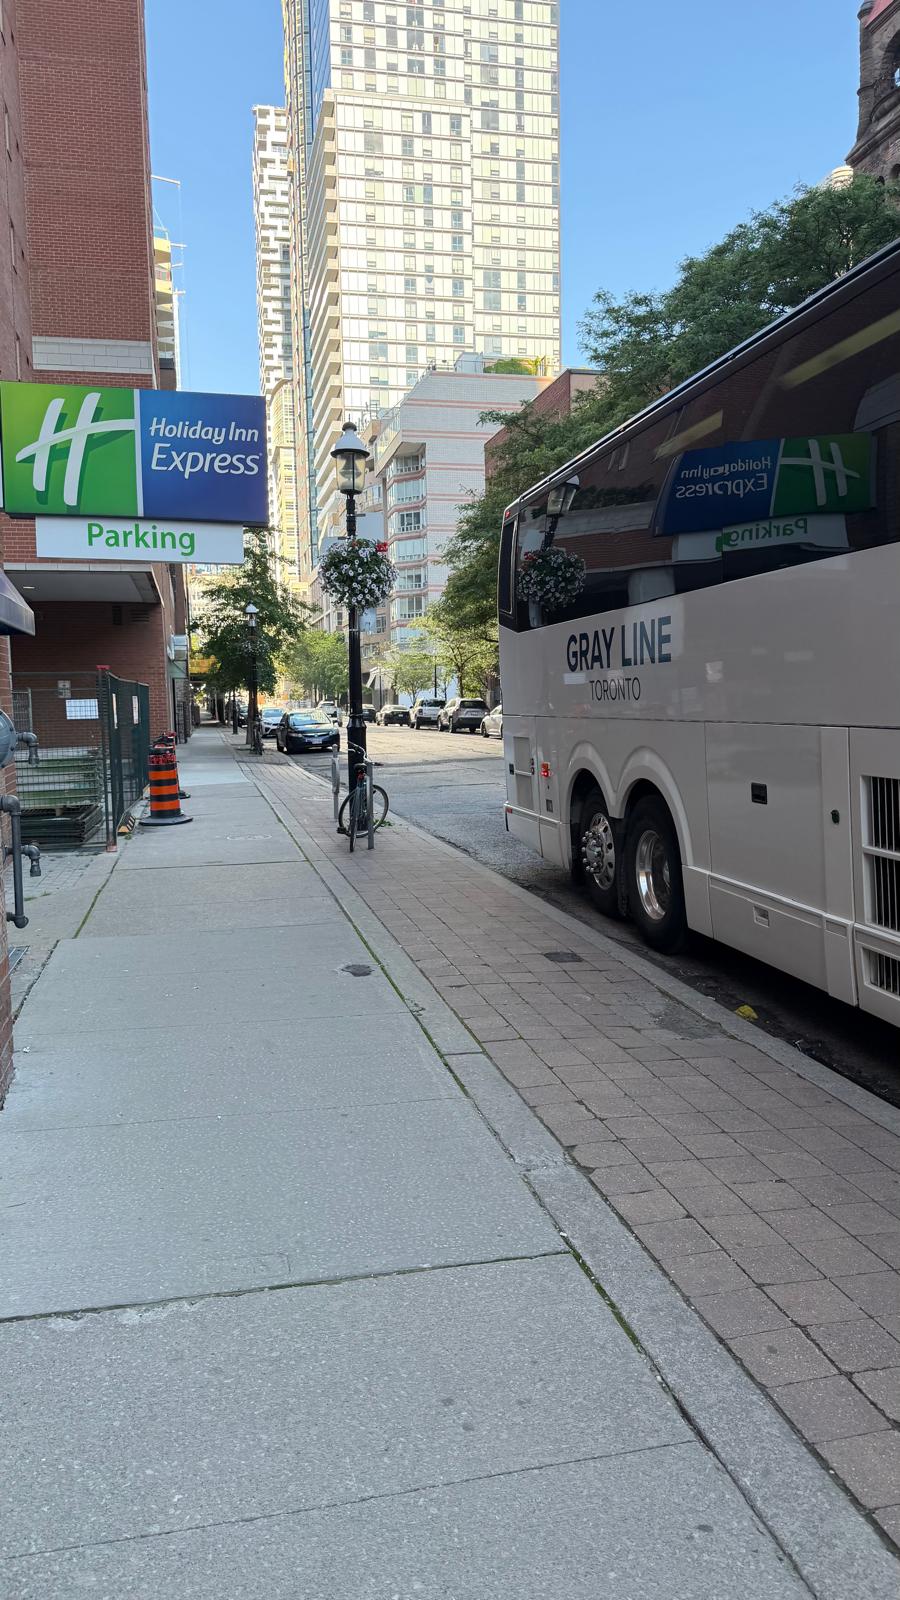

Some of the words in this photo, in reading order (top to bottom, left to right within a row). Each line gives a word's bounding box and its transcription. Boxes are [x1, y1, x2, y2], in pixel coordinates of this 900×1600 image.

[149, 417, 227, 443] Holiday
[229, 422, 259, 443] Inn
[151, 443, 260, 479] Express
[87, 522, 195, 556] Parking
[567, 627, 615, 673] GRAY
[621, 616, 671, 667] LINE
[590, 677, 641, 701] TORONTO
